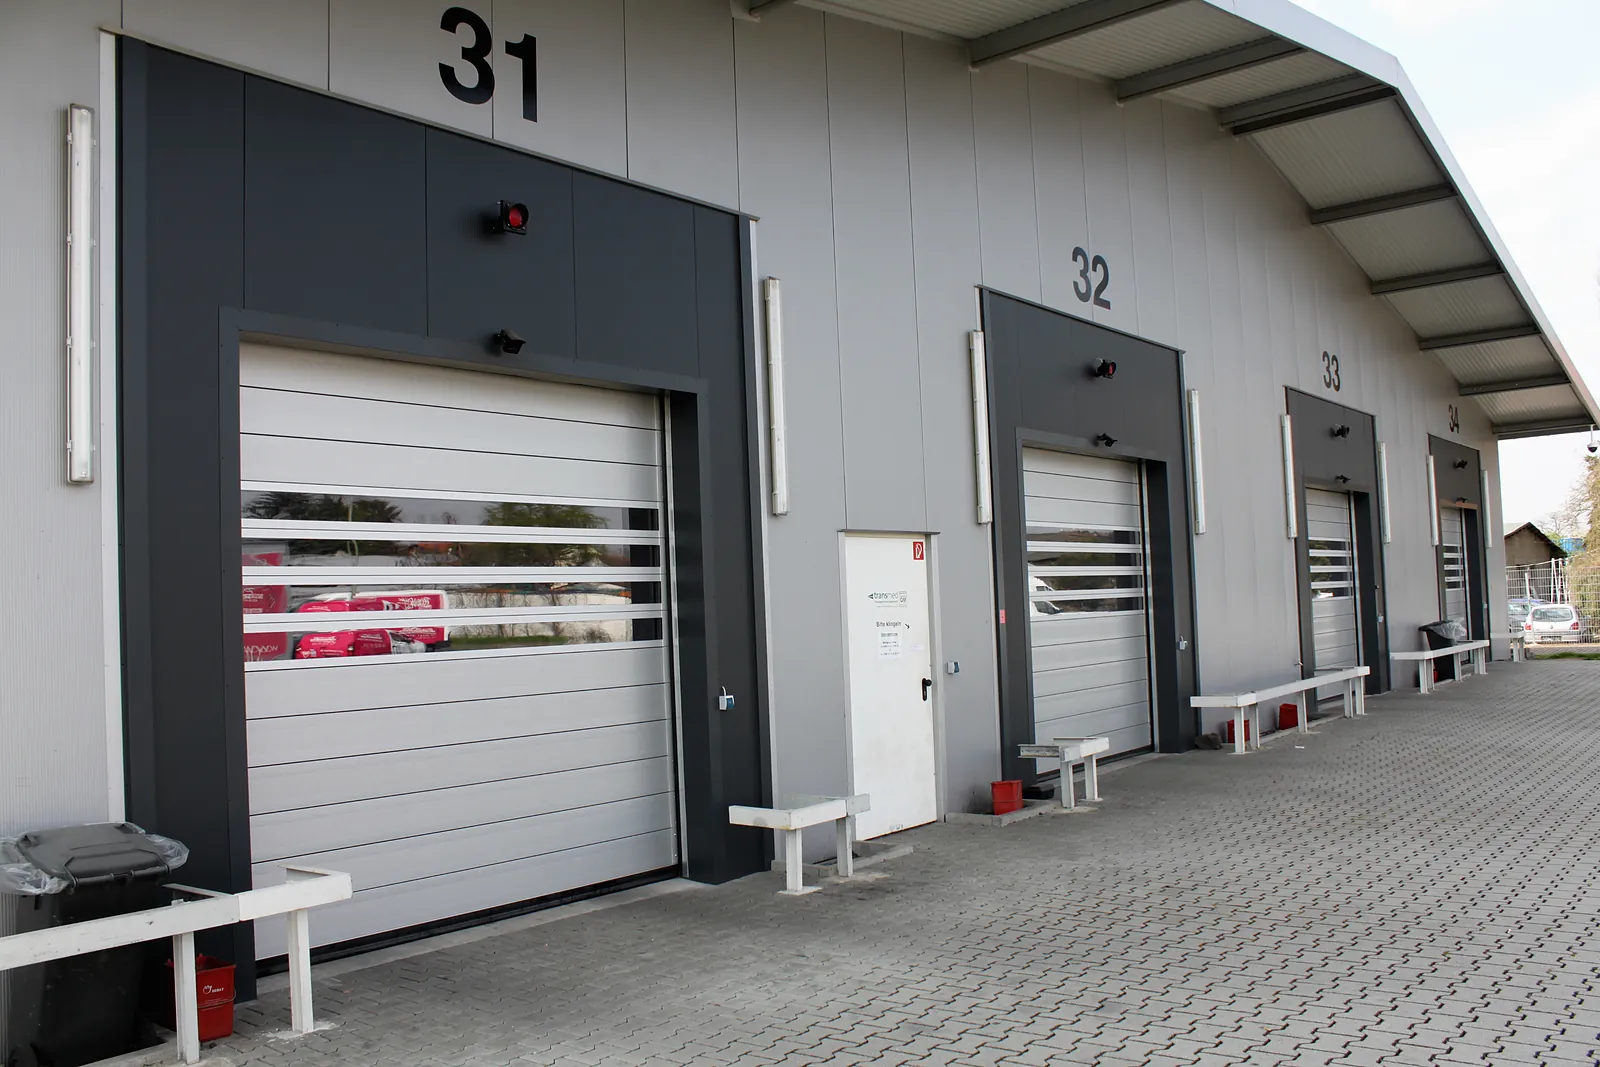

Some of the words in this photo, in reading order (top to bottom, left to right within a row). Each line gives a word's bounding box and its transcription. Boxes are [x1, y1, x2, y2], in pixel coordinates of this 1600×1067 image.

[438, 6, 538, 123] 31
[1071, 246, 1111, 310] 32
[1322, 350, 1341, 392] 33
[1448, 404, 1460, 434] 34
